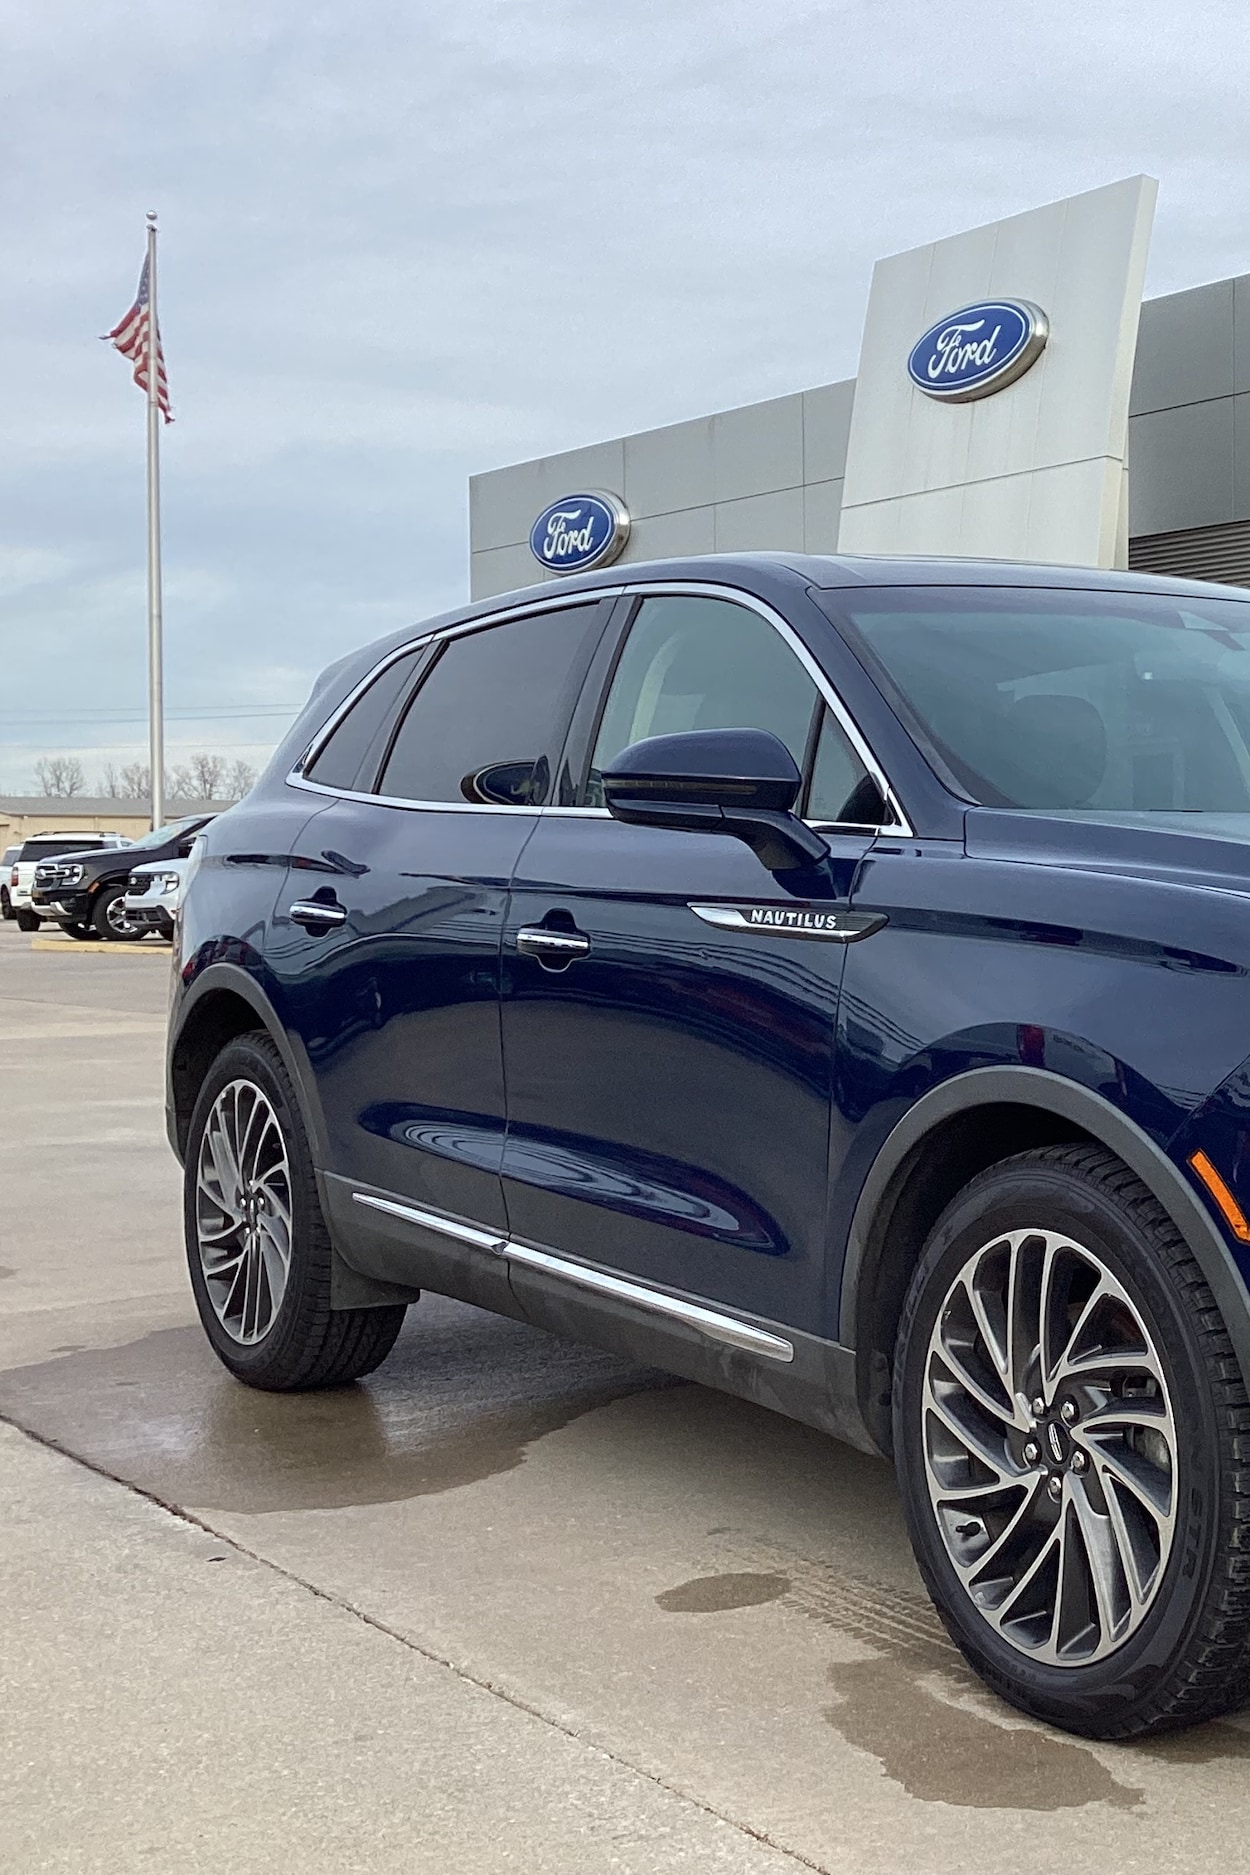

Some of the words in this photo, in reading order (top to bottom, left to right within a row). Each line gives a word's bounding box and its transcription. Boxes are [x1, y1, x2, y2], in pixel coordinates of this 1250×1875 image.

[927, 318, 1002, 379] Ford
[543, 509, 594, 559] Ford
[750, 909, 837, 929] NAUTILUS
